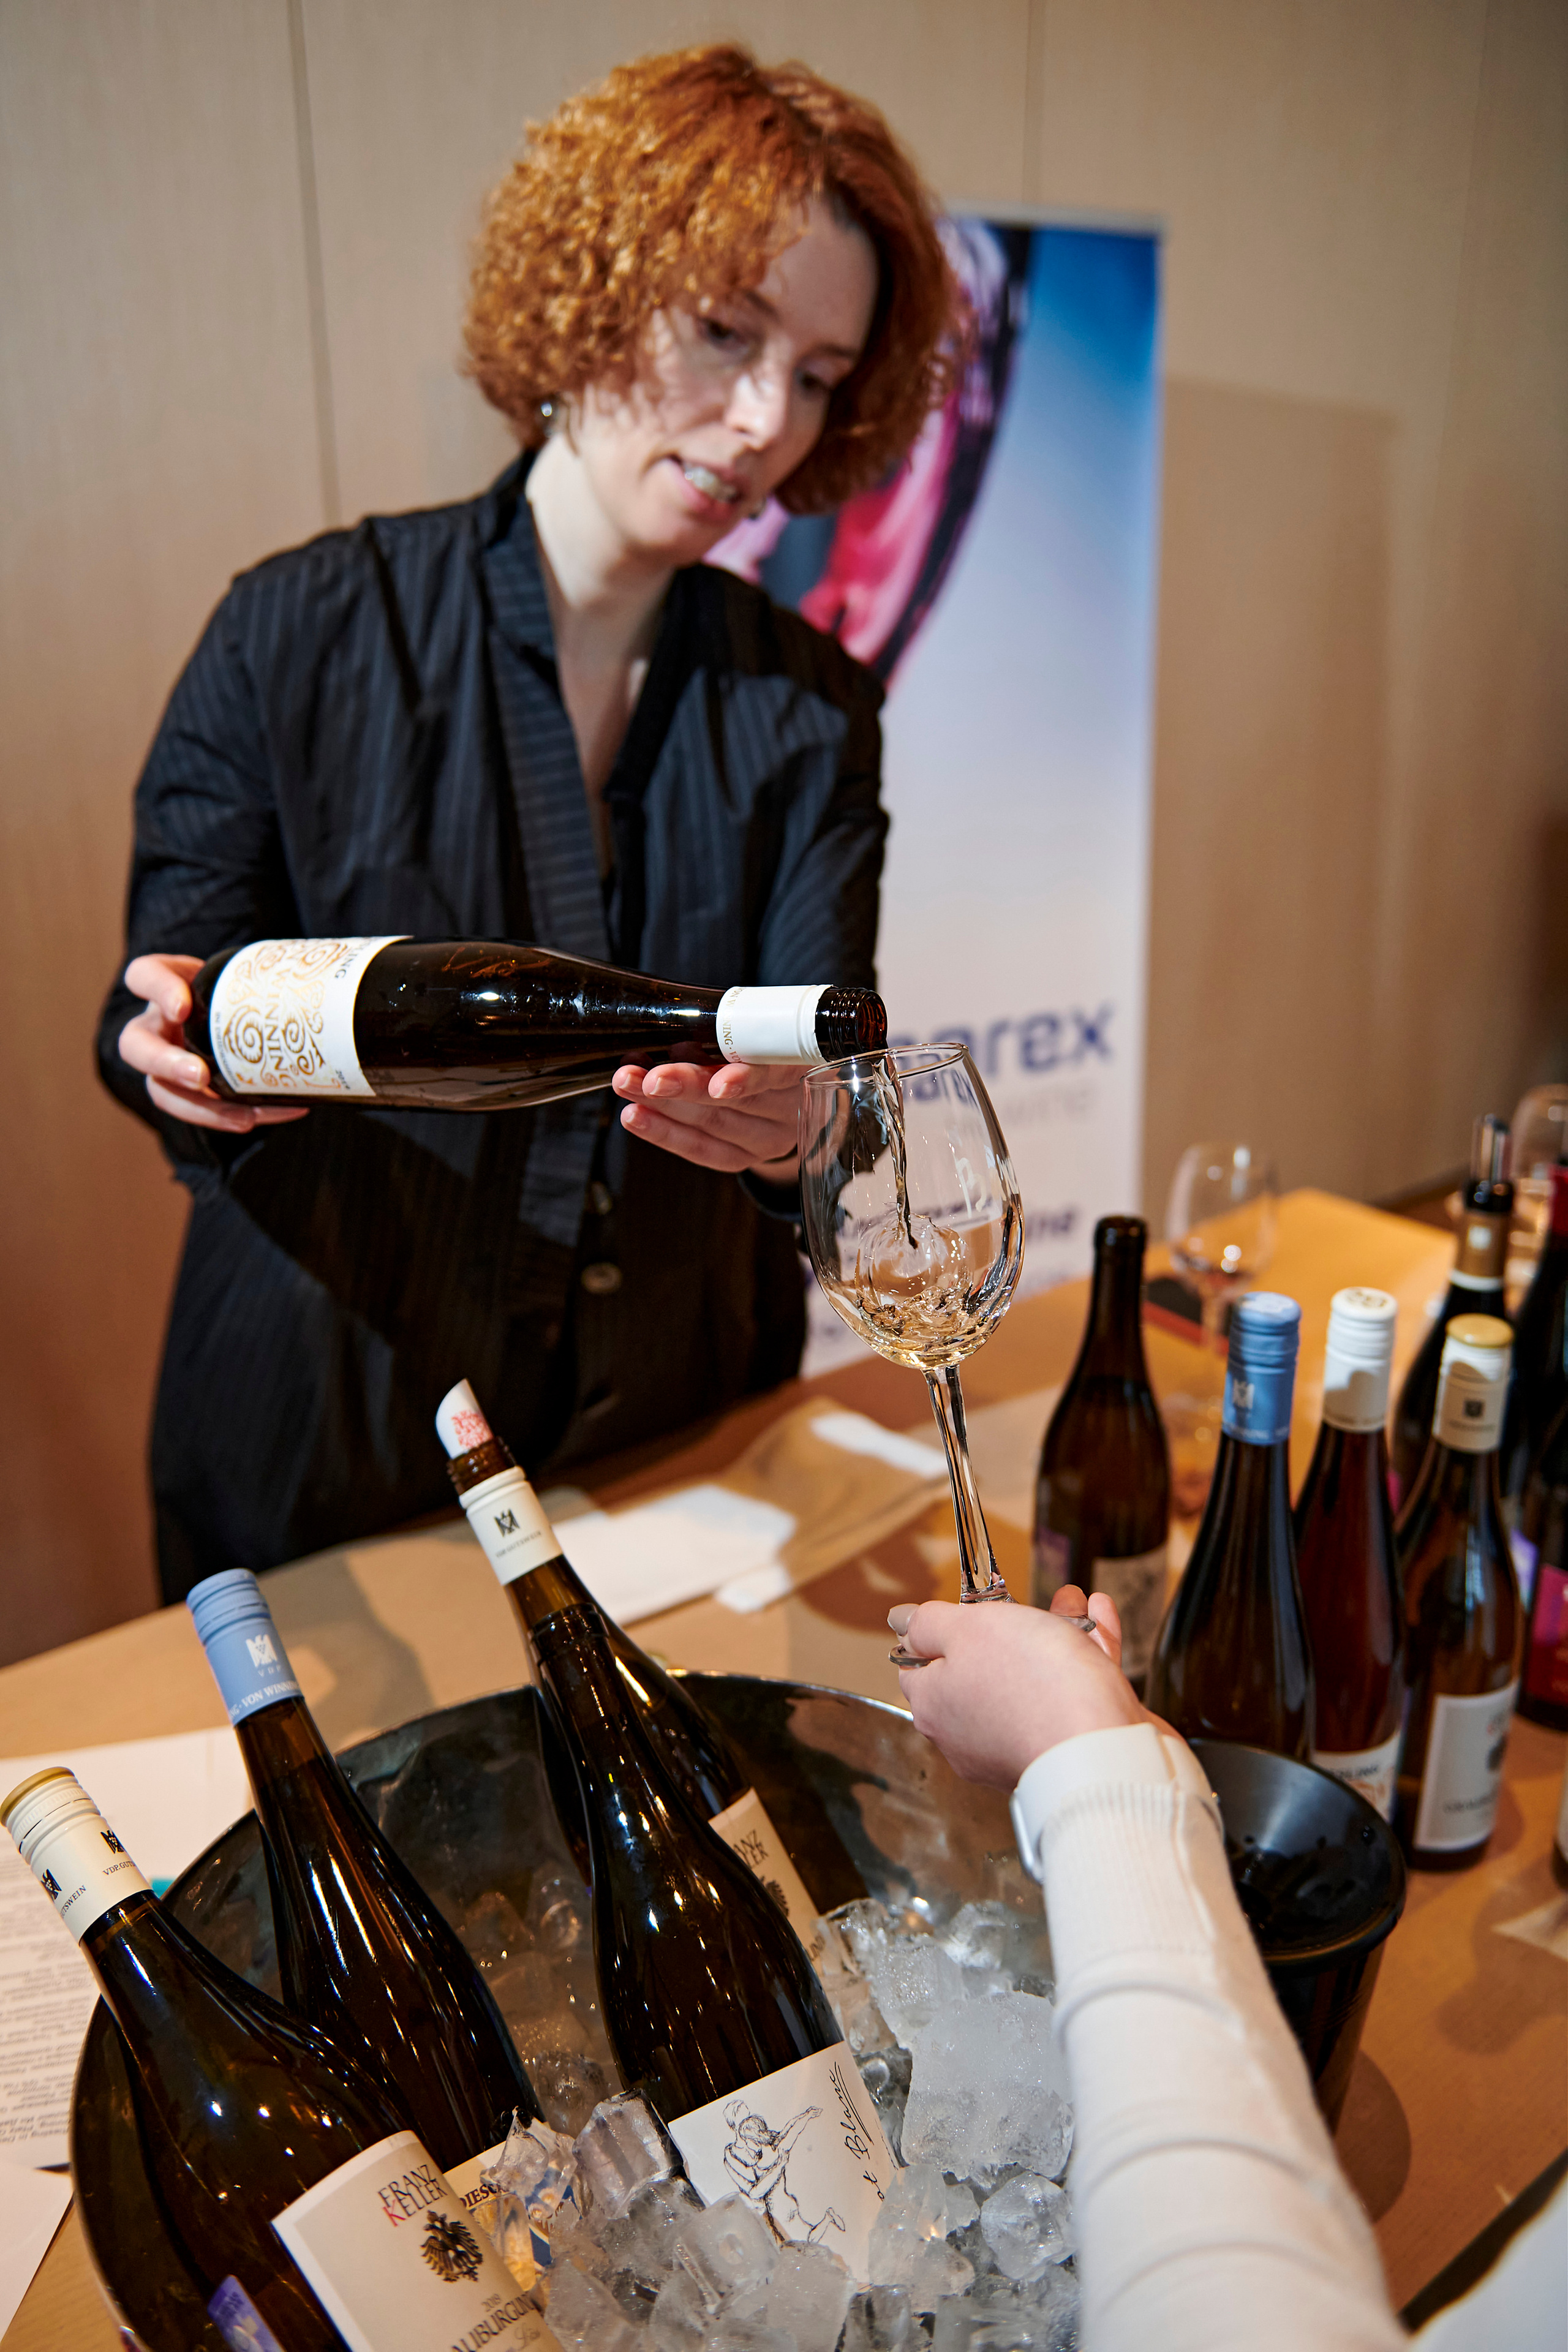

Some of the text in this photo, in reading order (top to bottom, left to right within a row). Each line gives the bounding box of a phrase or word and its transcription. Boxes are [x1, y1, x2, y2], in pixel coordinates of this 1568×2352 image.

[242, 1691, 264, 1707] VON
[829, 2068, 871, 2160] Blanc
[377, 2164, 431, 2208] FRANZ
[382, 2178, 448, 2227] KELLER
